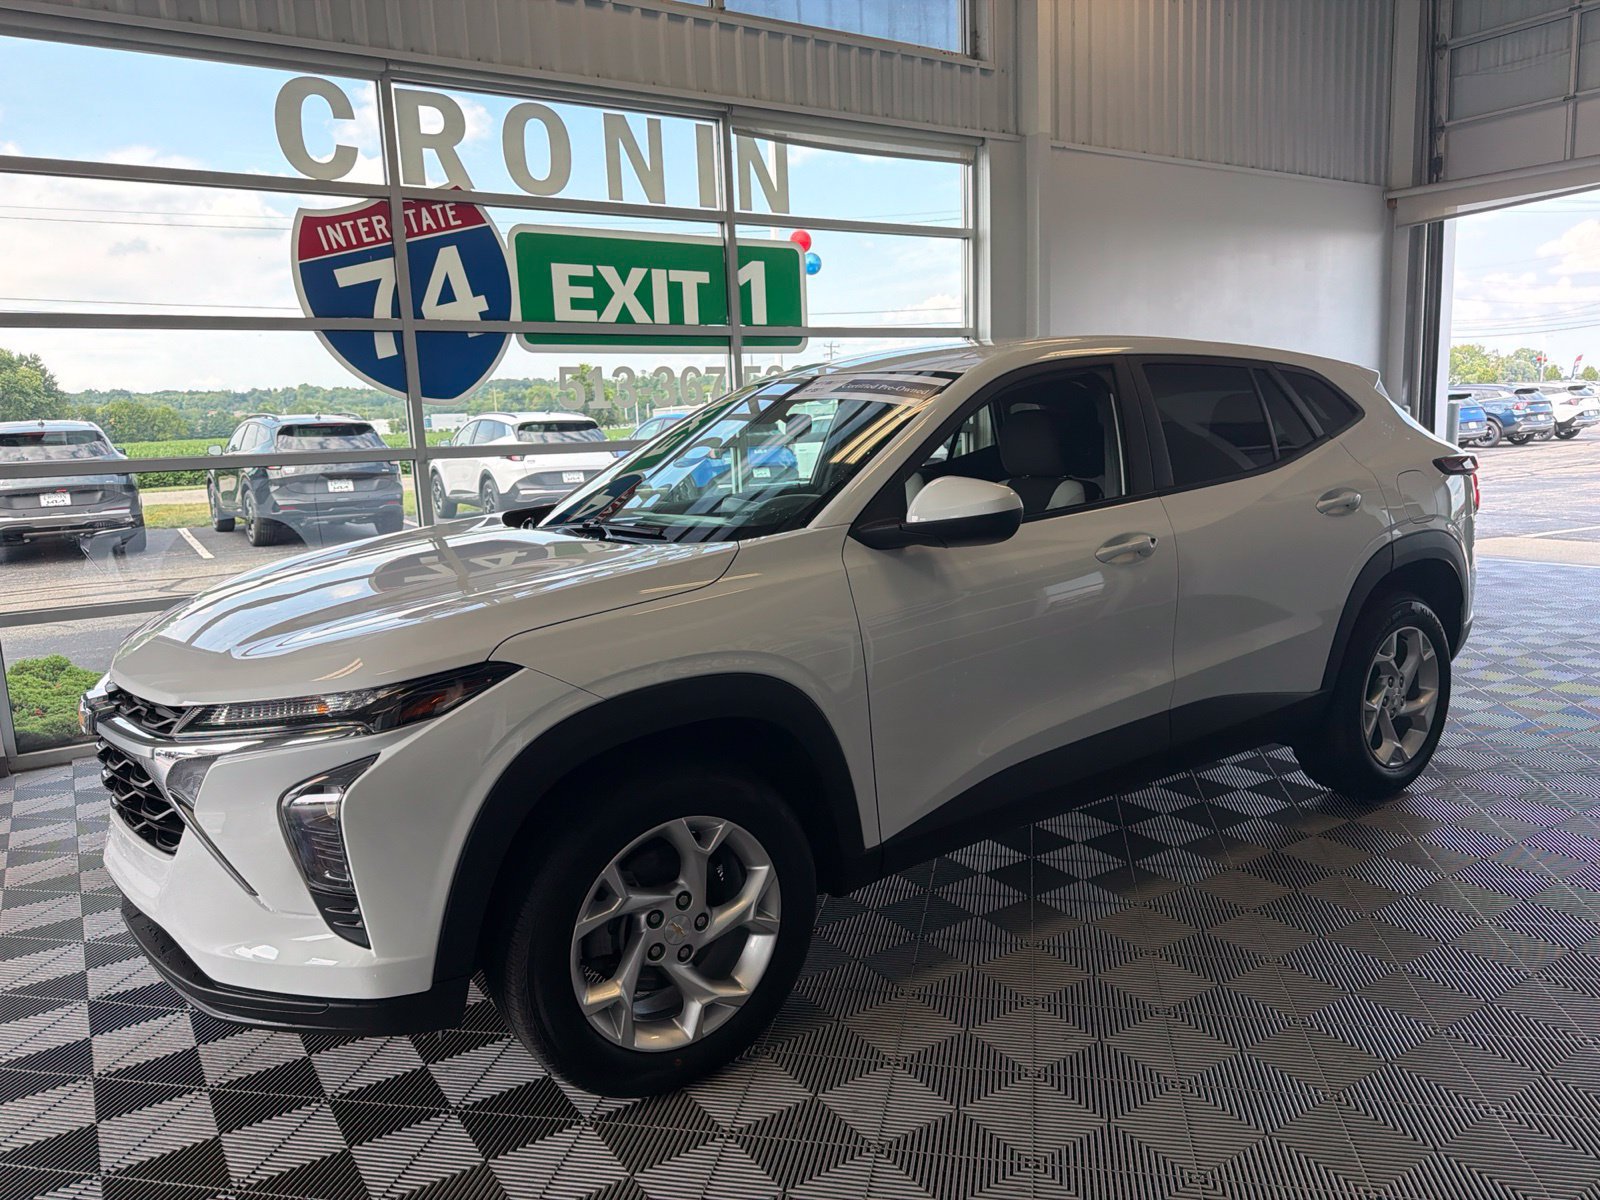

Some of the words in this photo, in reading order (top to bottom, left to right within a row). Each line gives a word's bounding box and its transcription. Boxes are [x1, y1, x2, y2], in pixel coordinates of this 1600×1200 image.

[275, 76, 790, 214] CRONIN
[317, 202, 462, 251] INTERTATE
[333, 245, 489, 359] 74
[551, 262, 710, 325] EXIT
[737, 260, 768, 325] 1
[879, 382, 930, 396] Pre-Owned
